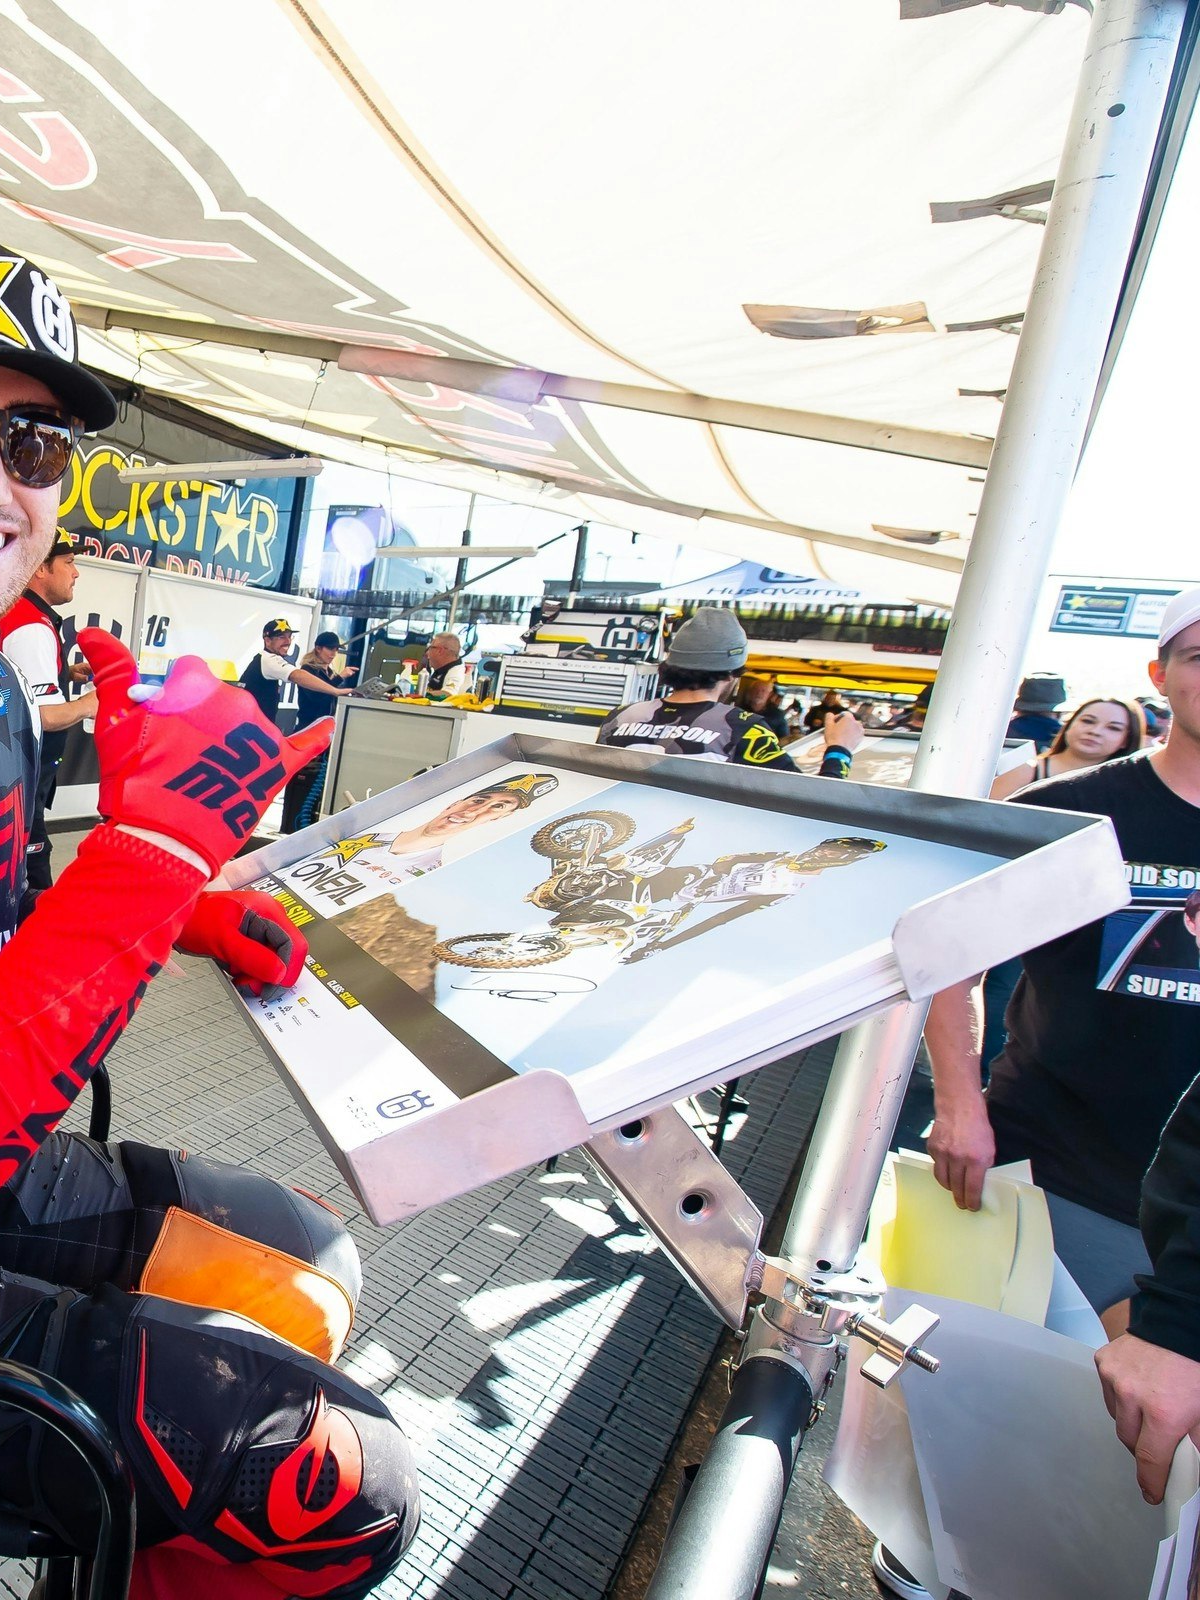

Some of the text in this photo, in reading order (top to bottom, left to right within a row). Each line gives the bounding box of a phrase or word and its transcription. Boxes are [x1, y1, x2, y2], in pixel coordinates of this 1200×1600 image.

[707, 587, 861, 598] Husqvarna
[145, 614, 170, 647] 16
[613, 723, 721, 745] ANDERSON
[1163, 869, 1200, 889] SO
[1127, 974, 1200, 1002] SUPER
